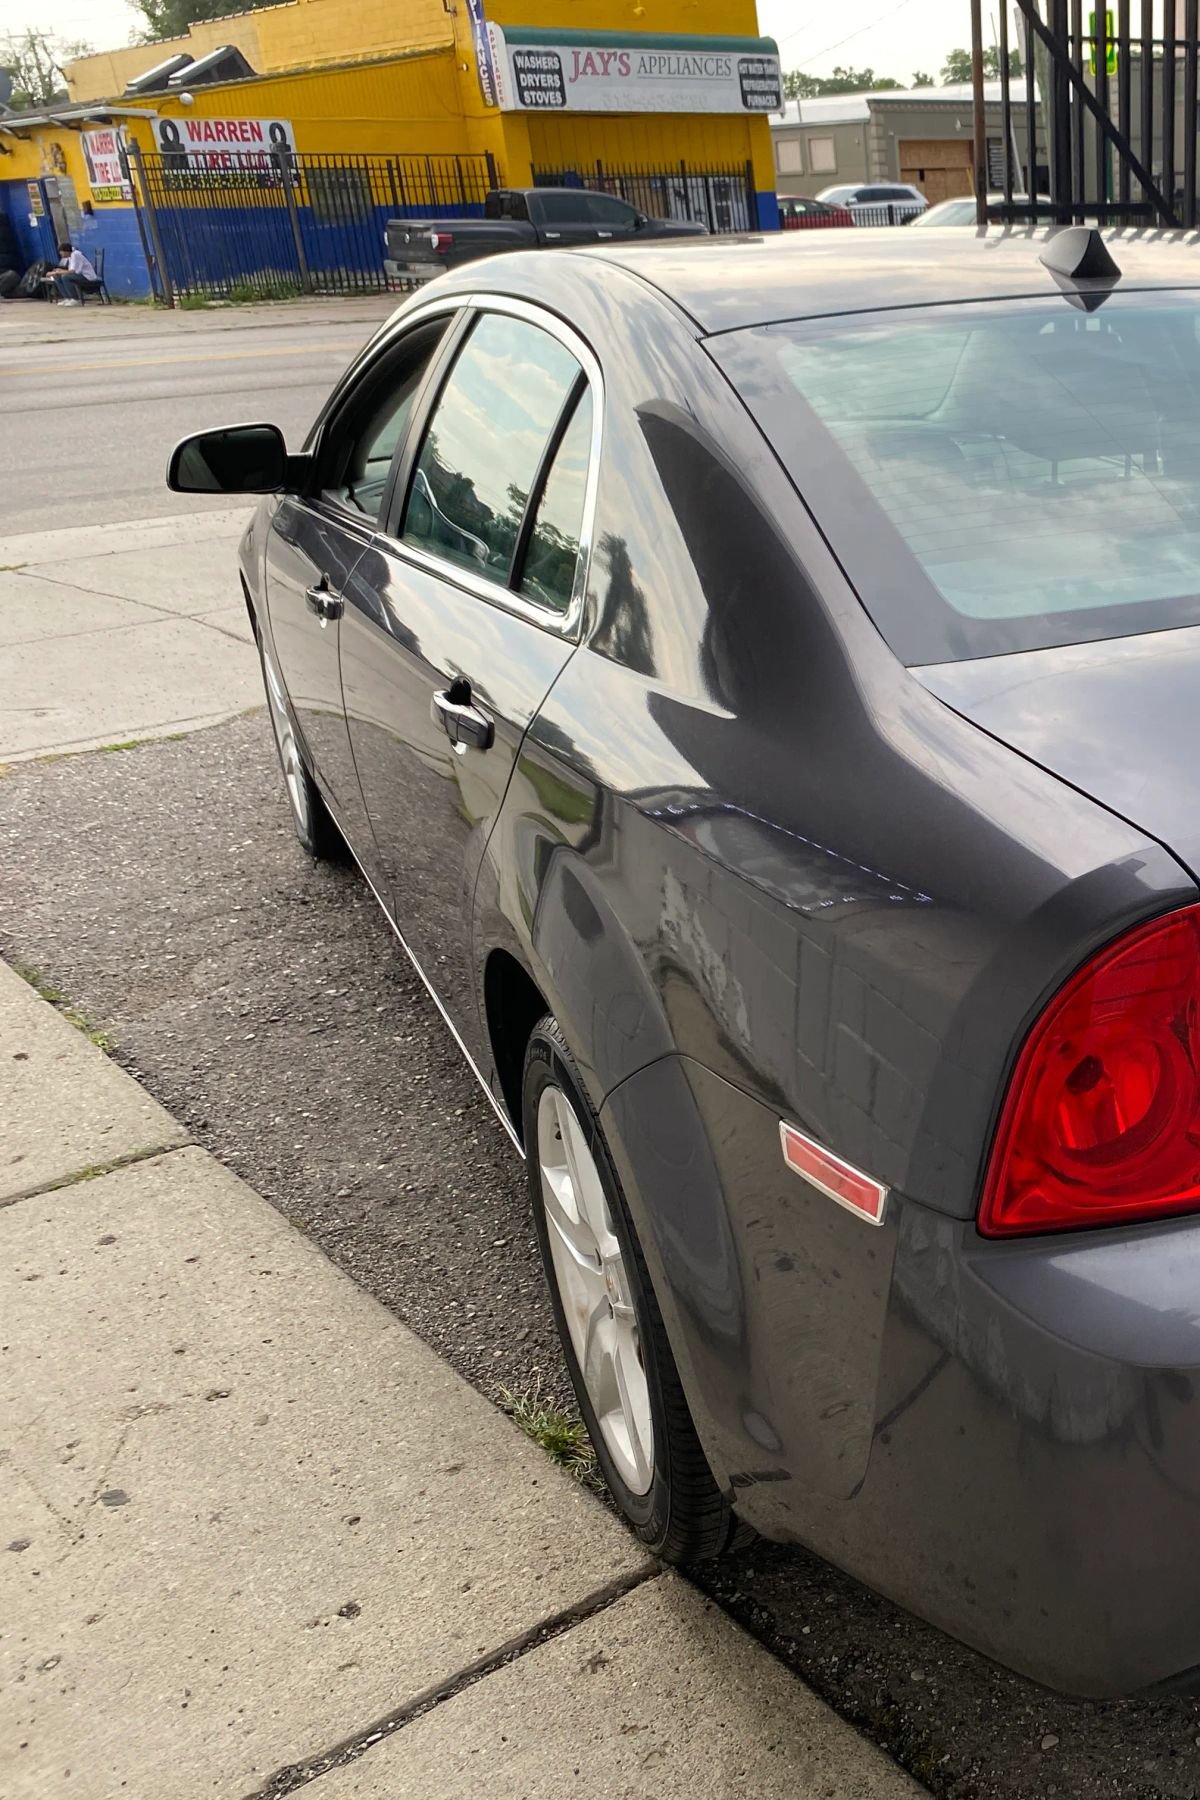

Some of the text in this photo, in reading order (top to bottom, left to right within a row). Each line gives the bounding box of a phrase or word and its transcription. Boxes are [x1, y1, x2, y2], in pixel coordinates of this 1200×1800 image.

[514, 52, 560, 69] WASHERS
[569, 51, 732, 82] JAY'S APPLIANCES
[519, 74, 561, 88] DRYERS
[523, 90, 563, 105] STOVES
[747, 95, 777, 106] FURNACES
[185, 120, 264, 143] WARREN
